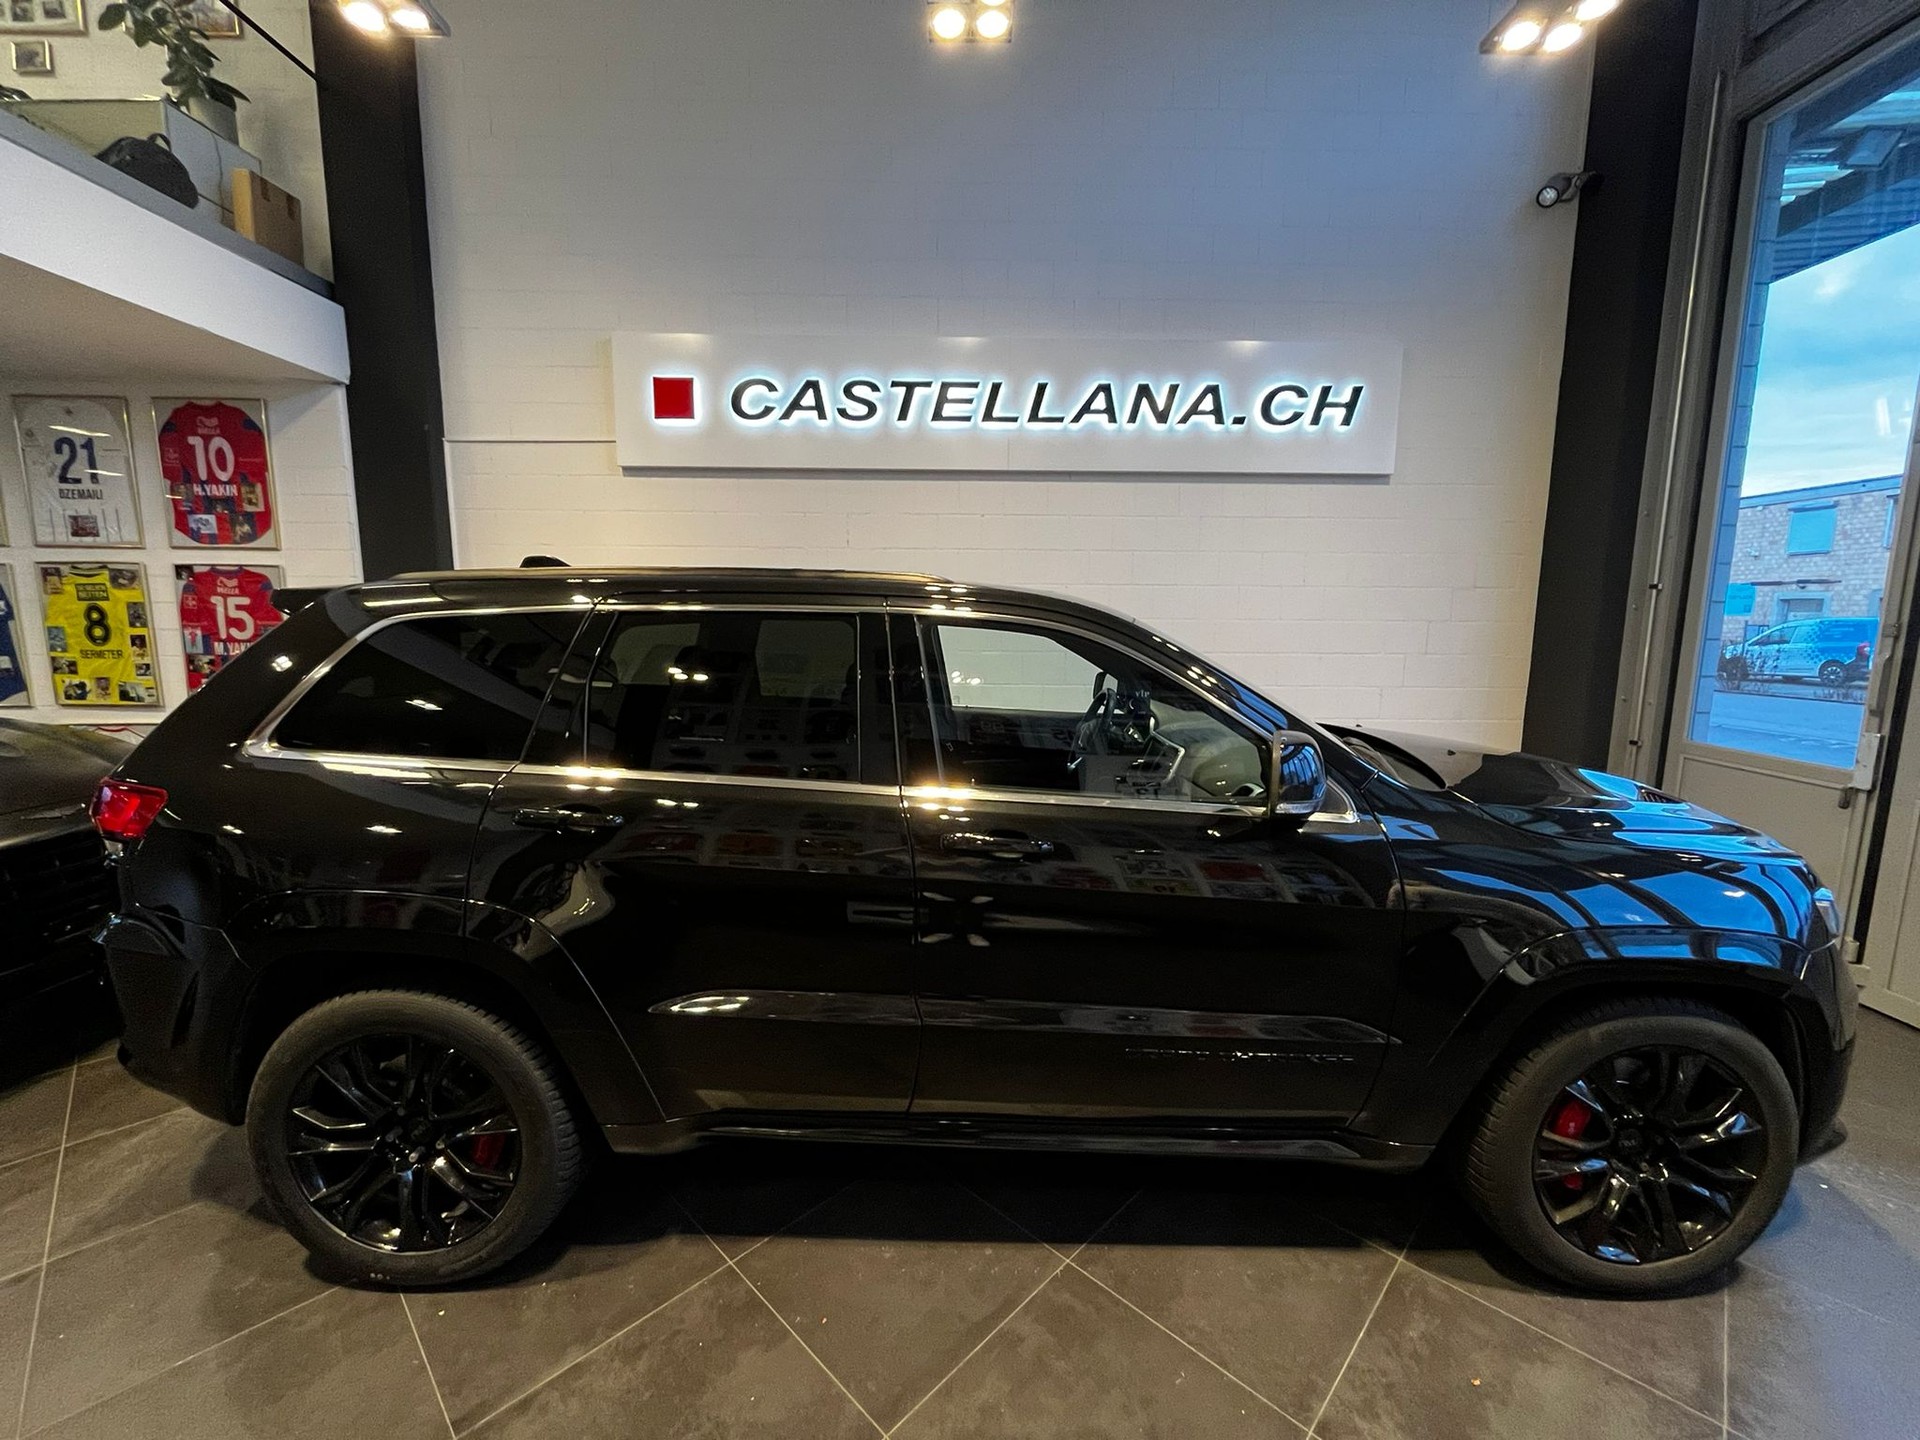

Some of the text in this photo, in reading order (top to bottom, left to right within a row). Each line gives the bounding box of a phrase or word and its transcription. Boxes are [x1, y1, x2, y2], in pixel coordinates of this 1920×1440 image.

[731, 378, 1364, 426] CASTELLANA.CH
[54, 436, 100, 485] 21
[187, 436, 235, 482] 10
[83, 602, 112, 647] 8
[210, 595, 255, 640] 15
